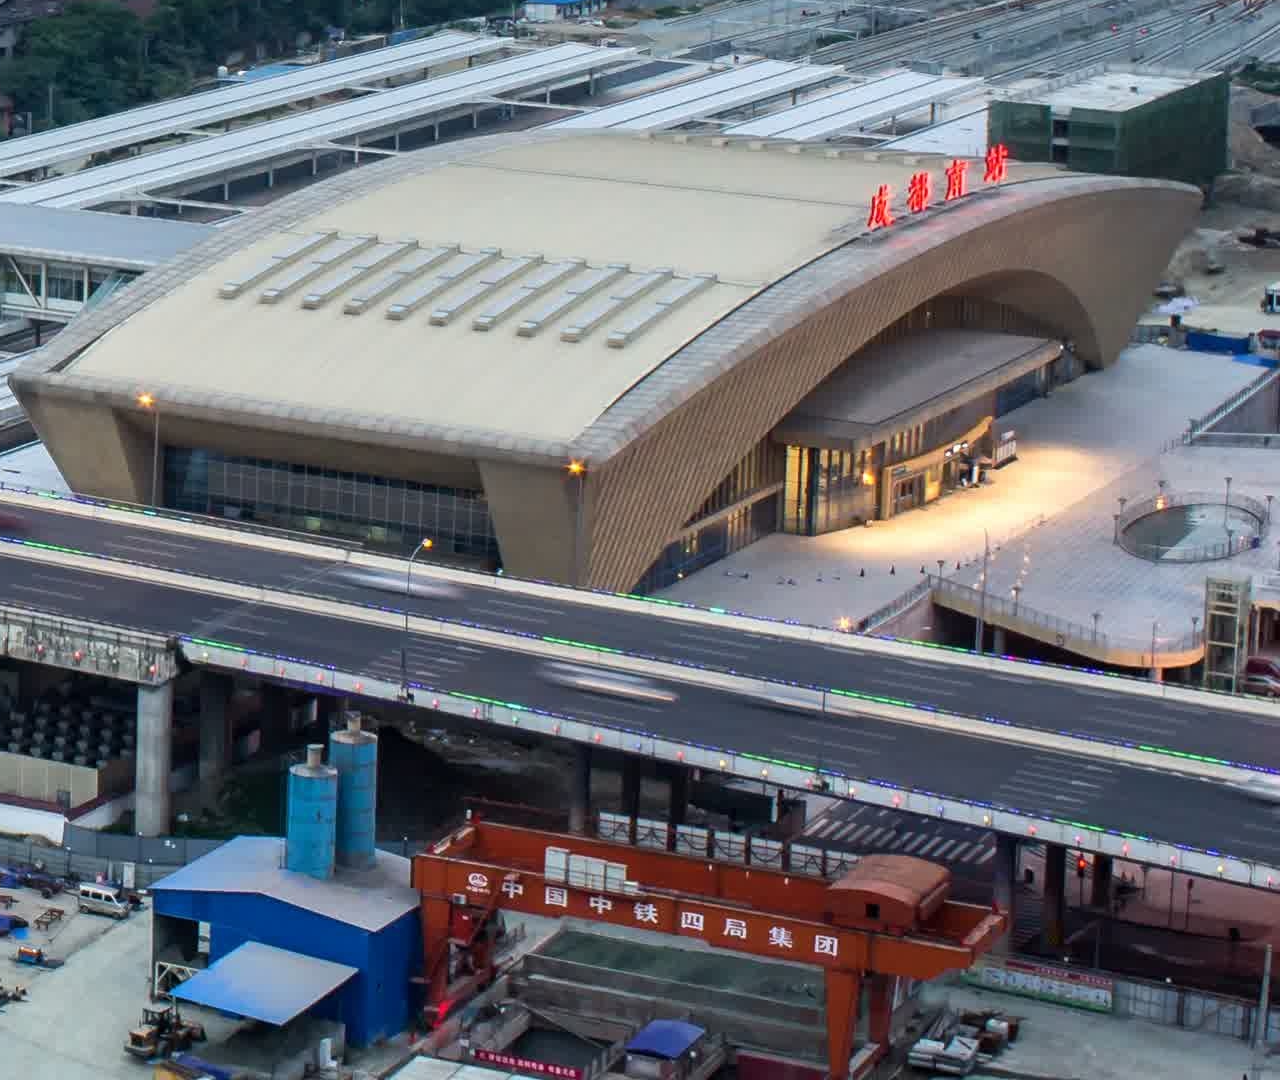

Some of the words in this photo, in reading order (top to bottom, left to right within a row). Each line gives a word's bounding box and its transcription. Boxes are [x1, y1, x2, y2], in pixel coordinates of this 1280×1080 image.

[867, 144, 1008, 232] 成都南站
[501, 879, 839, 957] 中国中铁四局集团
